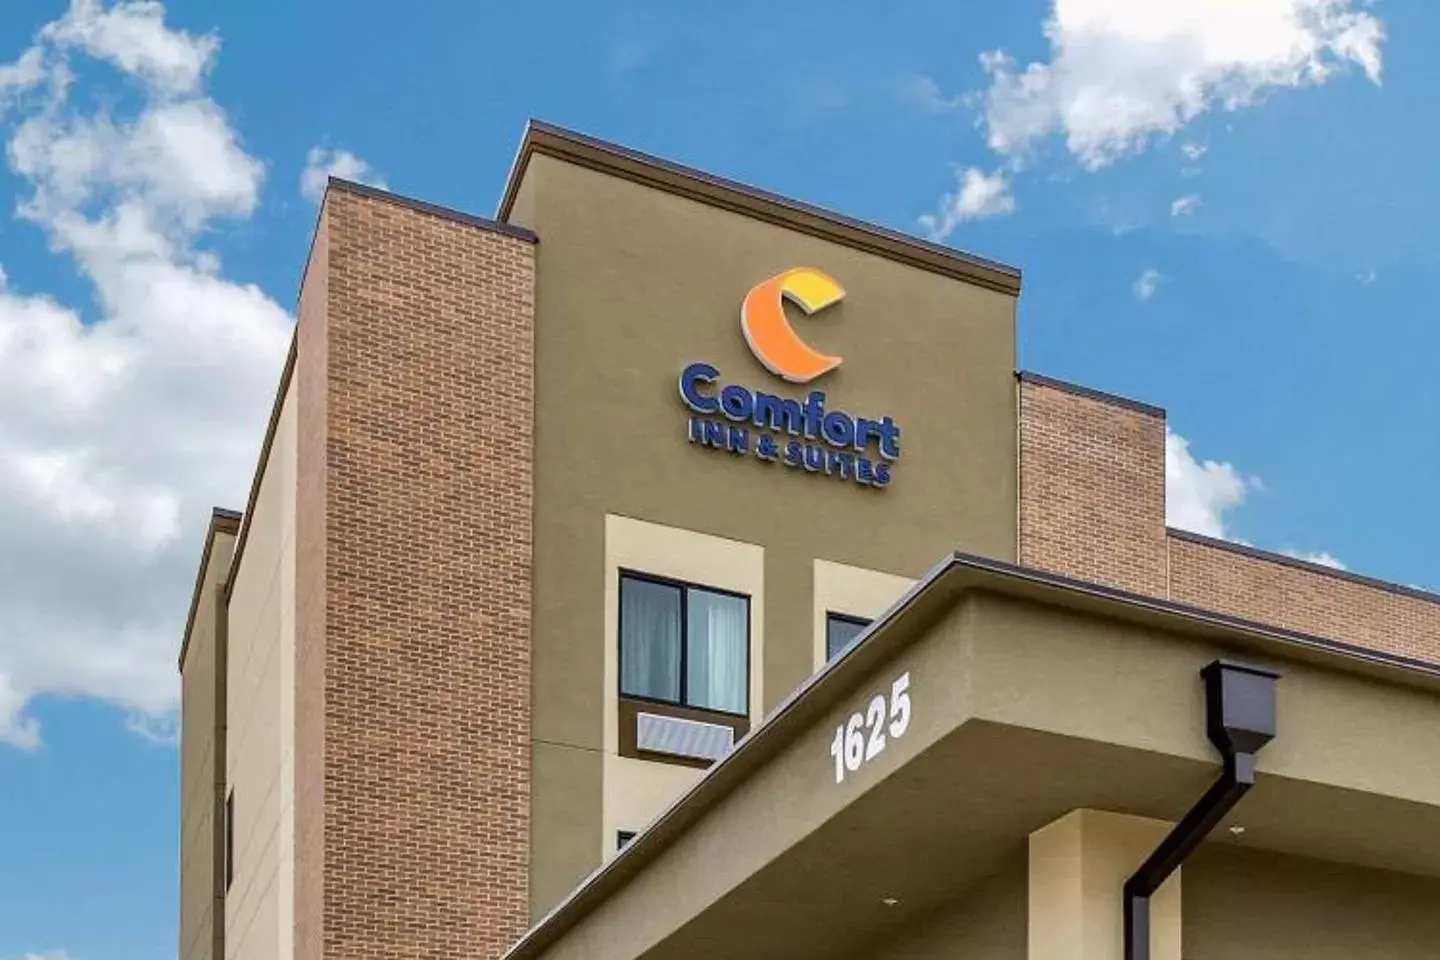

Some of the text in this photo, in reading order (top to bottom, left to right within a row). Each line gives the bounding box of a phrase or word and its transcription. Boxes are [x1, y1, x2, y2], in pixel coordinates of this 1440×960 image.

[678, 362, 901, 460] Comfort
[688, 417, 891, 487] INN & SUITES
[831, 671, 911, 784] 1625
